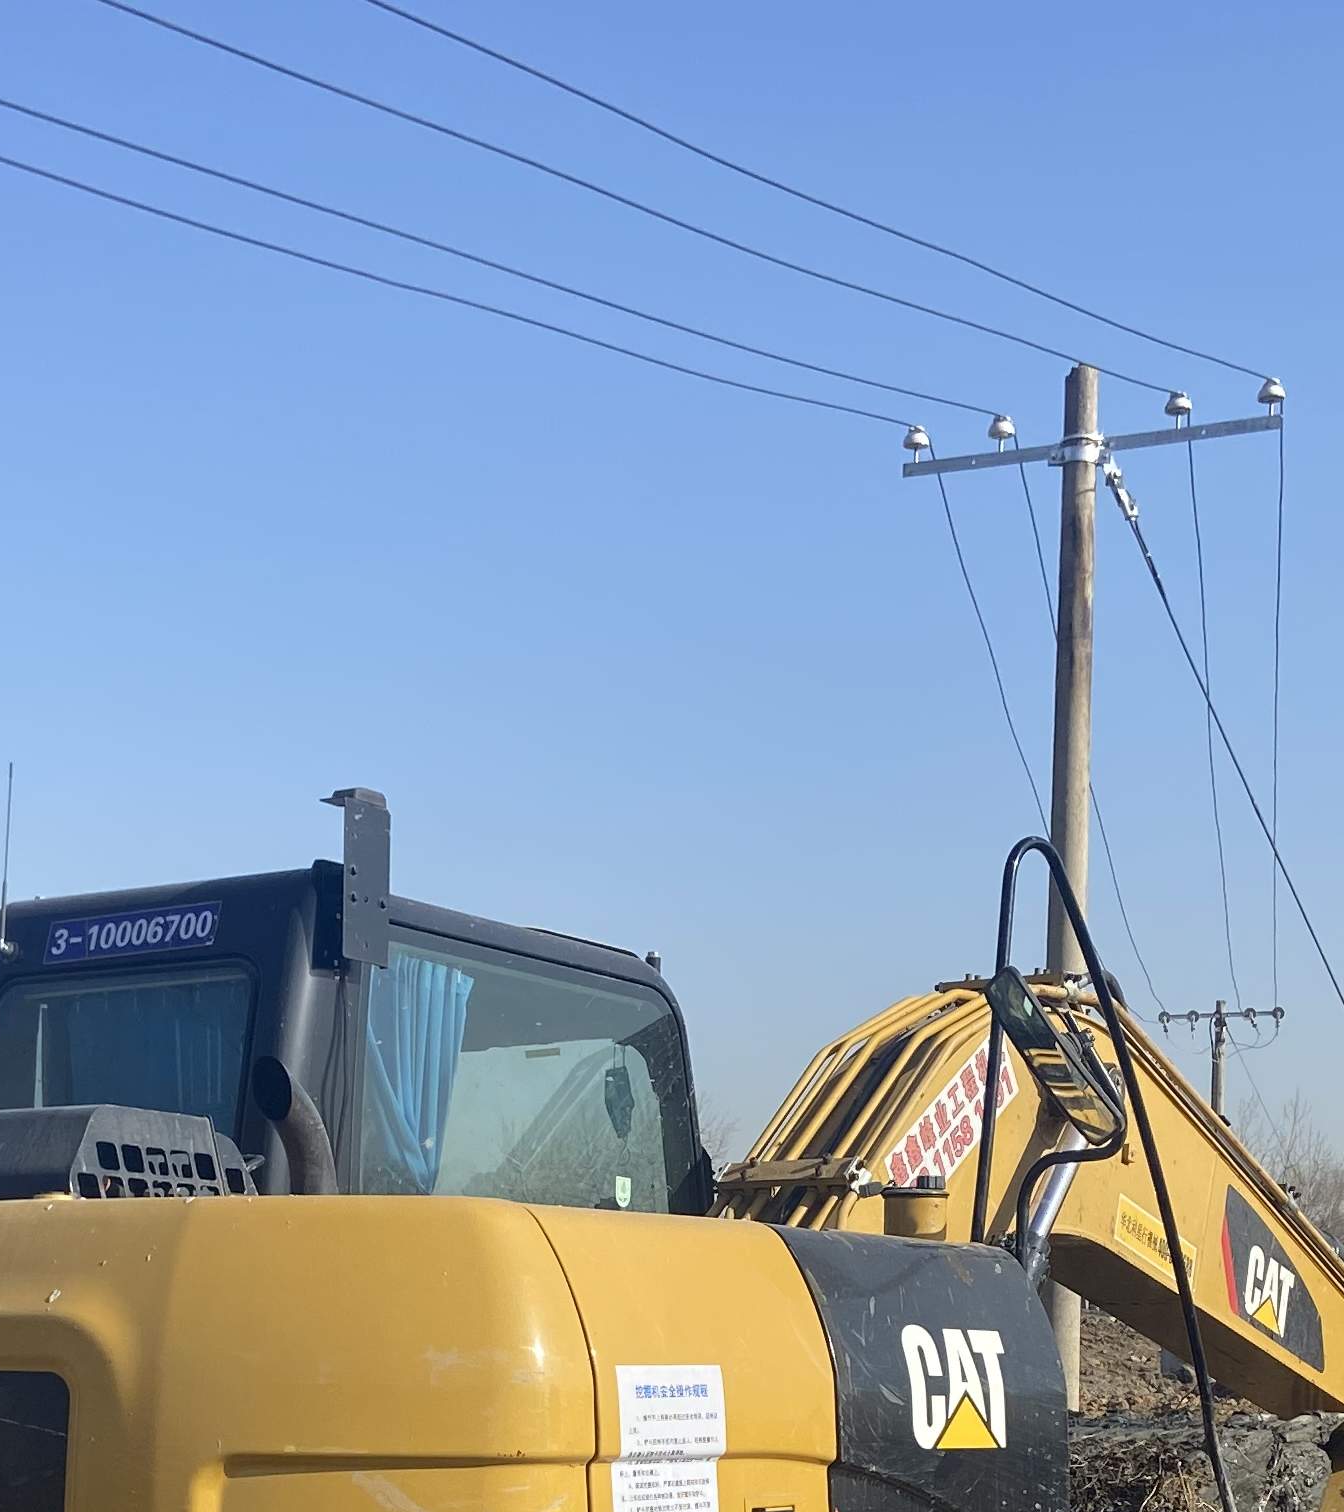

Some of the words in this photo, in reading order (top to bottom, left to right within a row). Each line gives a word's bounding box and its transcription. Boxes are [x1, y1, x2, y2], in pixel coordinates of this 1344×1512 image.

[50, 910, 212, 956] 3-10006700
[1244, 1244, 1297, 1338] CAT
[901, 1324, 1008, 1451] CAT
